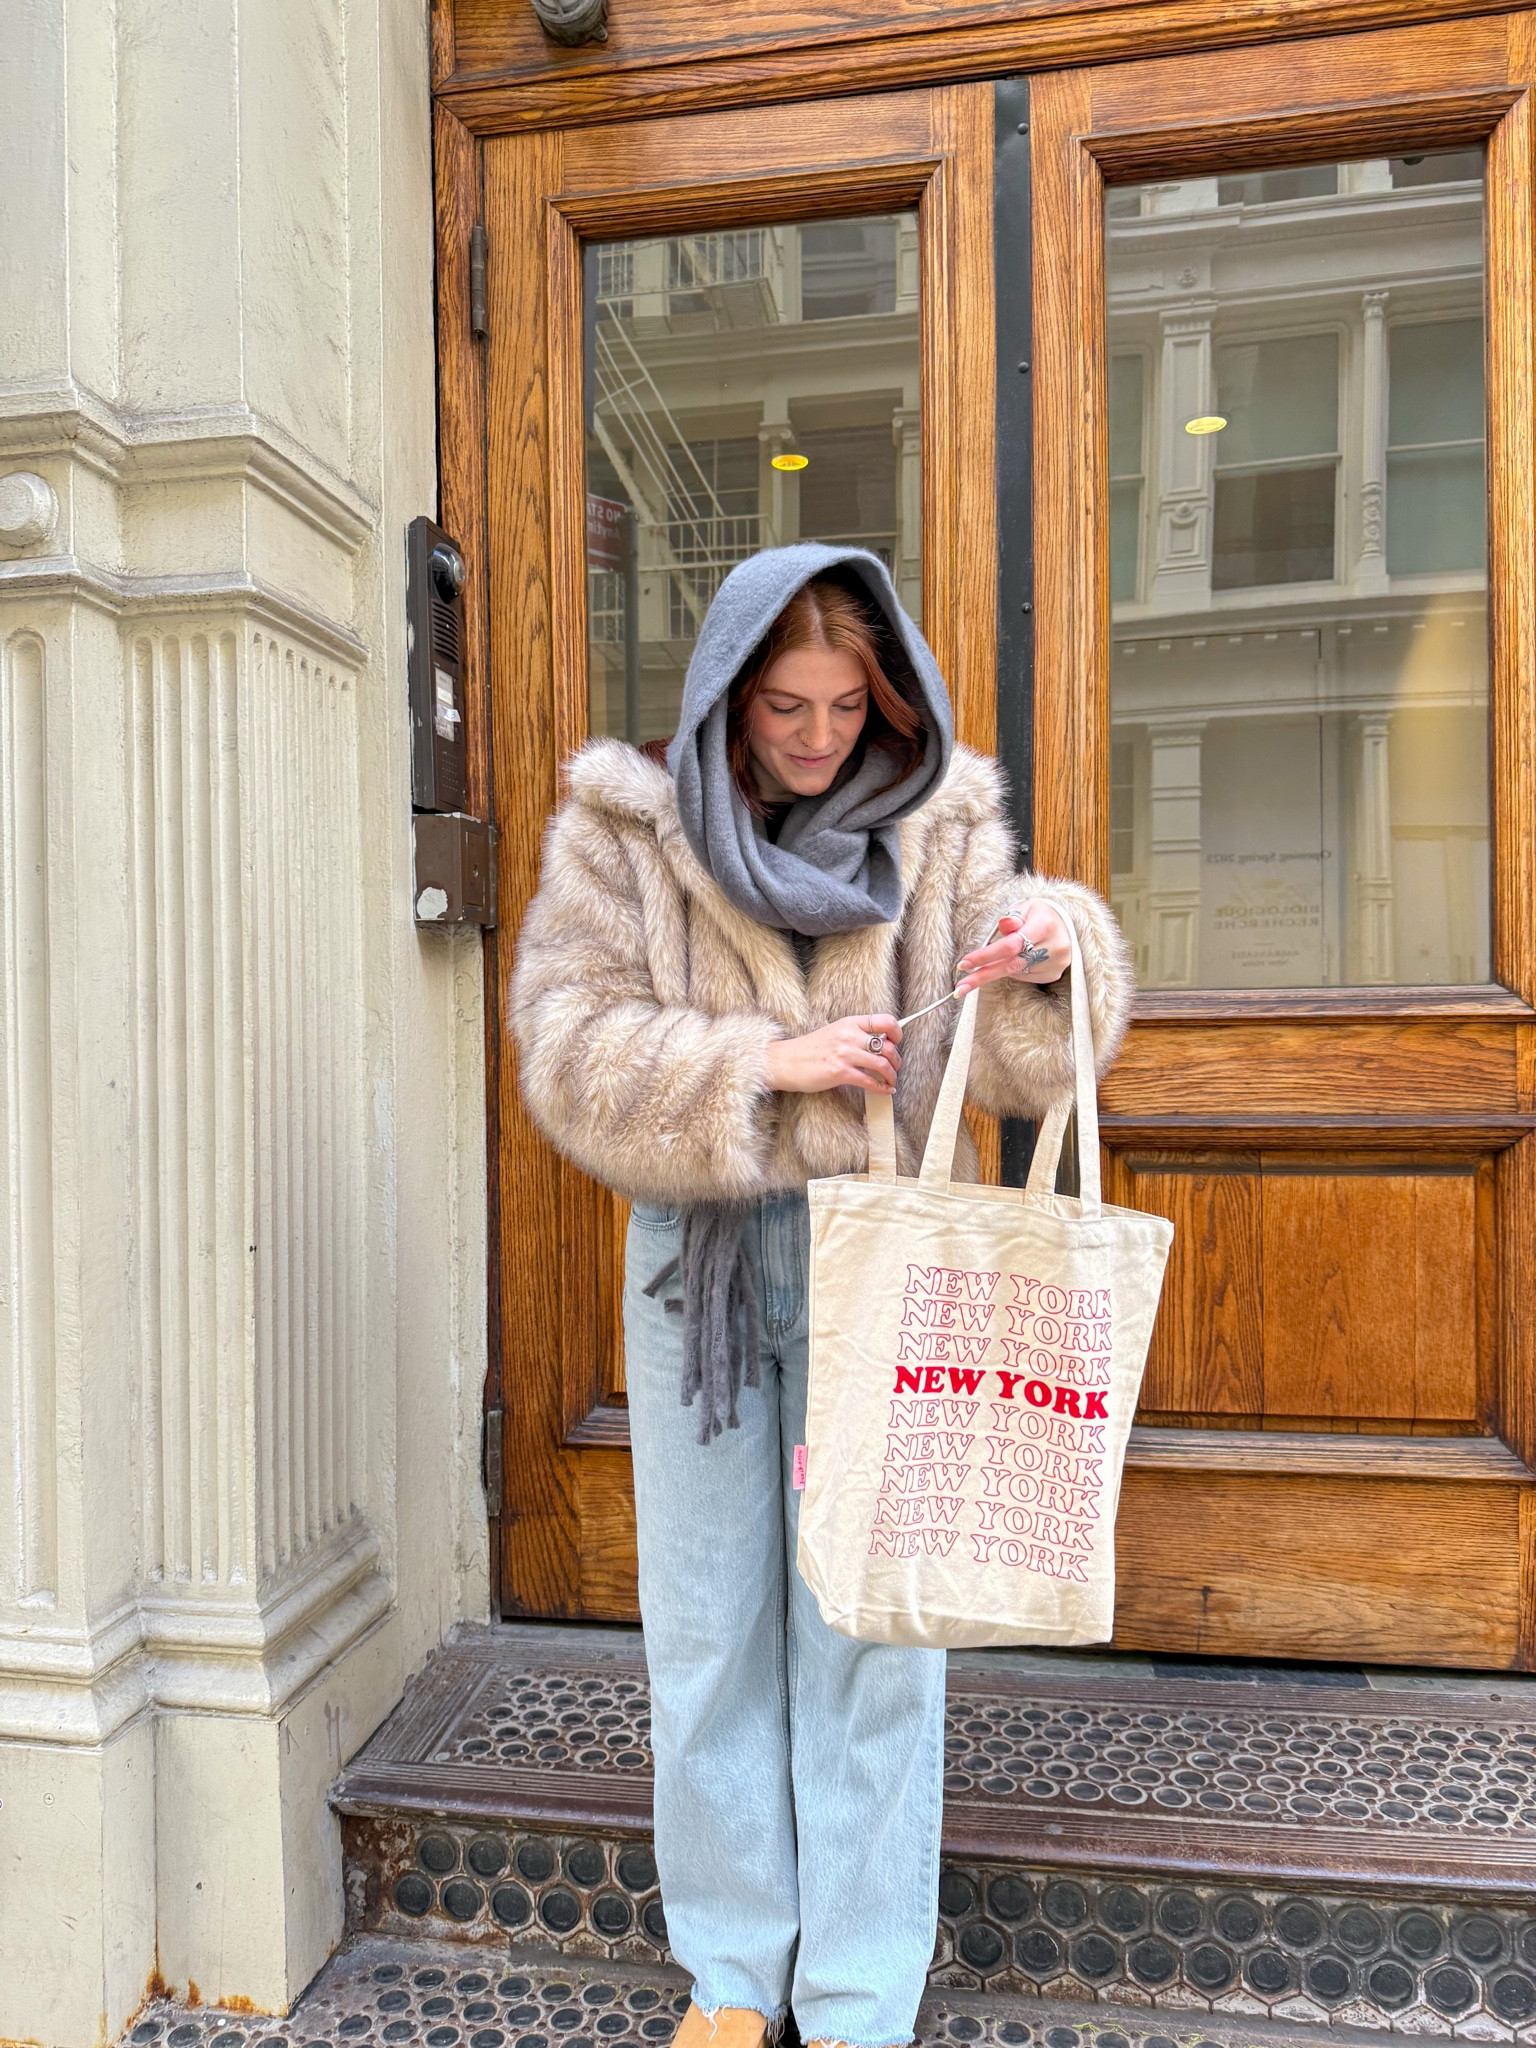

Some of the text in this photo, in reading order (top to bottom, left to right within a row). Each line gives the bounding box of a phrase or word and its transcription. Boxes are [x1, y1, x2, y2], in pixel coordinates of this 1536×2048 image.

[905, 1264, 1112, 1319] NEW YORK
[901, 1297, 1112, 1352] NEW YORK
[897, 1332, 1111, 1385] NEW YORK
[893, 1366, 1109, 1419] NEW YORK
[888, 1399, 1106, 1454] NEW YORK
[884, 1432, 1103, 1487] NEW YORK
[879, 1463, 1100, 1518] NEW YORK
[874, 1496, 1094, 1551] NEW YORK
[868, 1529, 1088, 1582] NEW YORK
